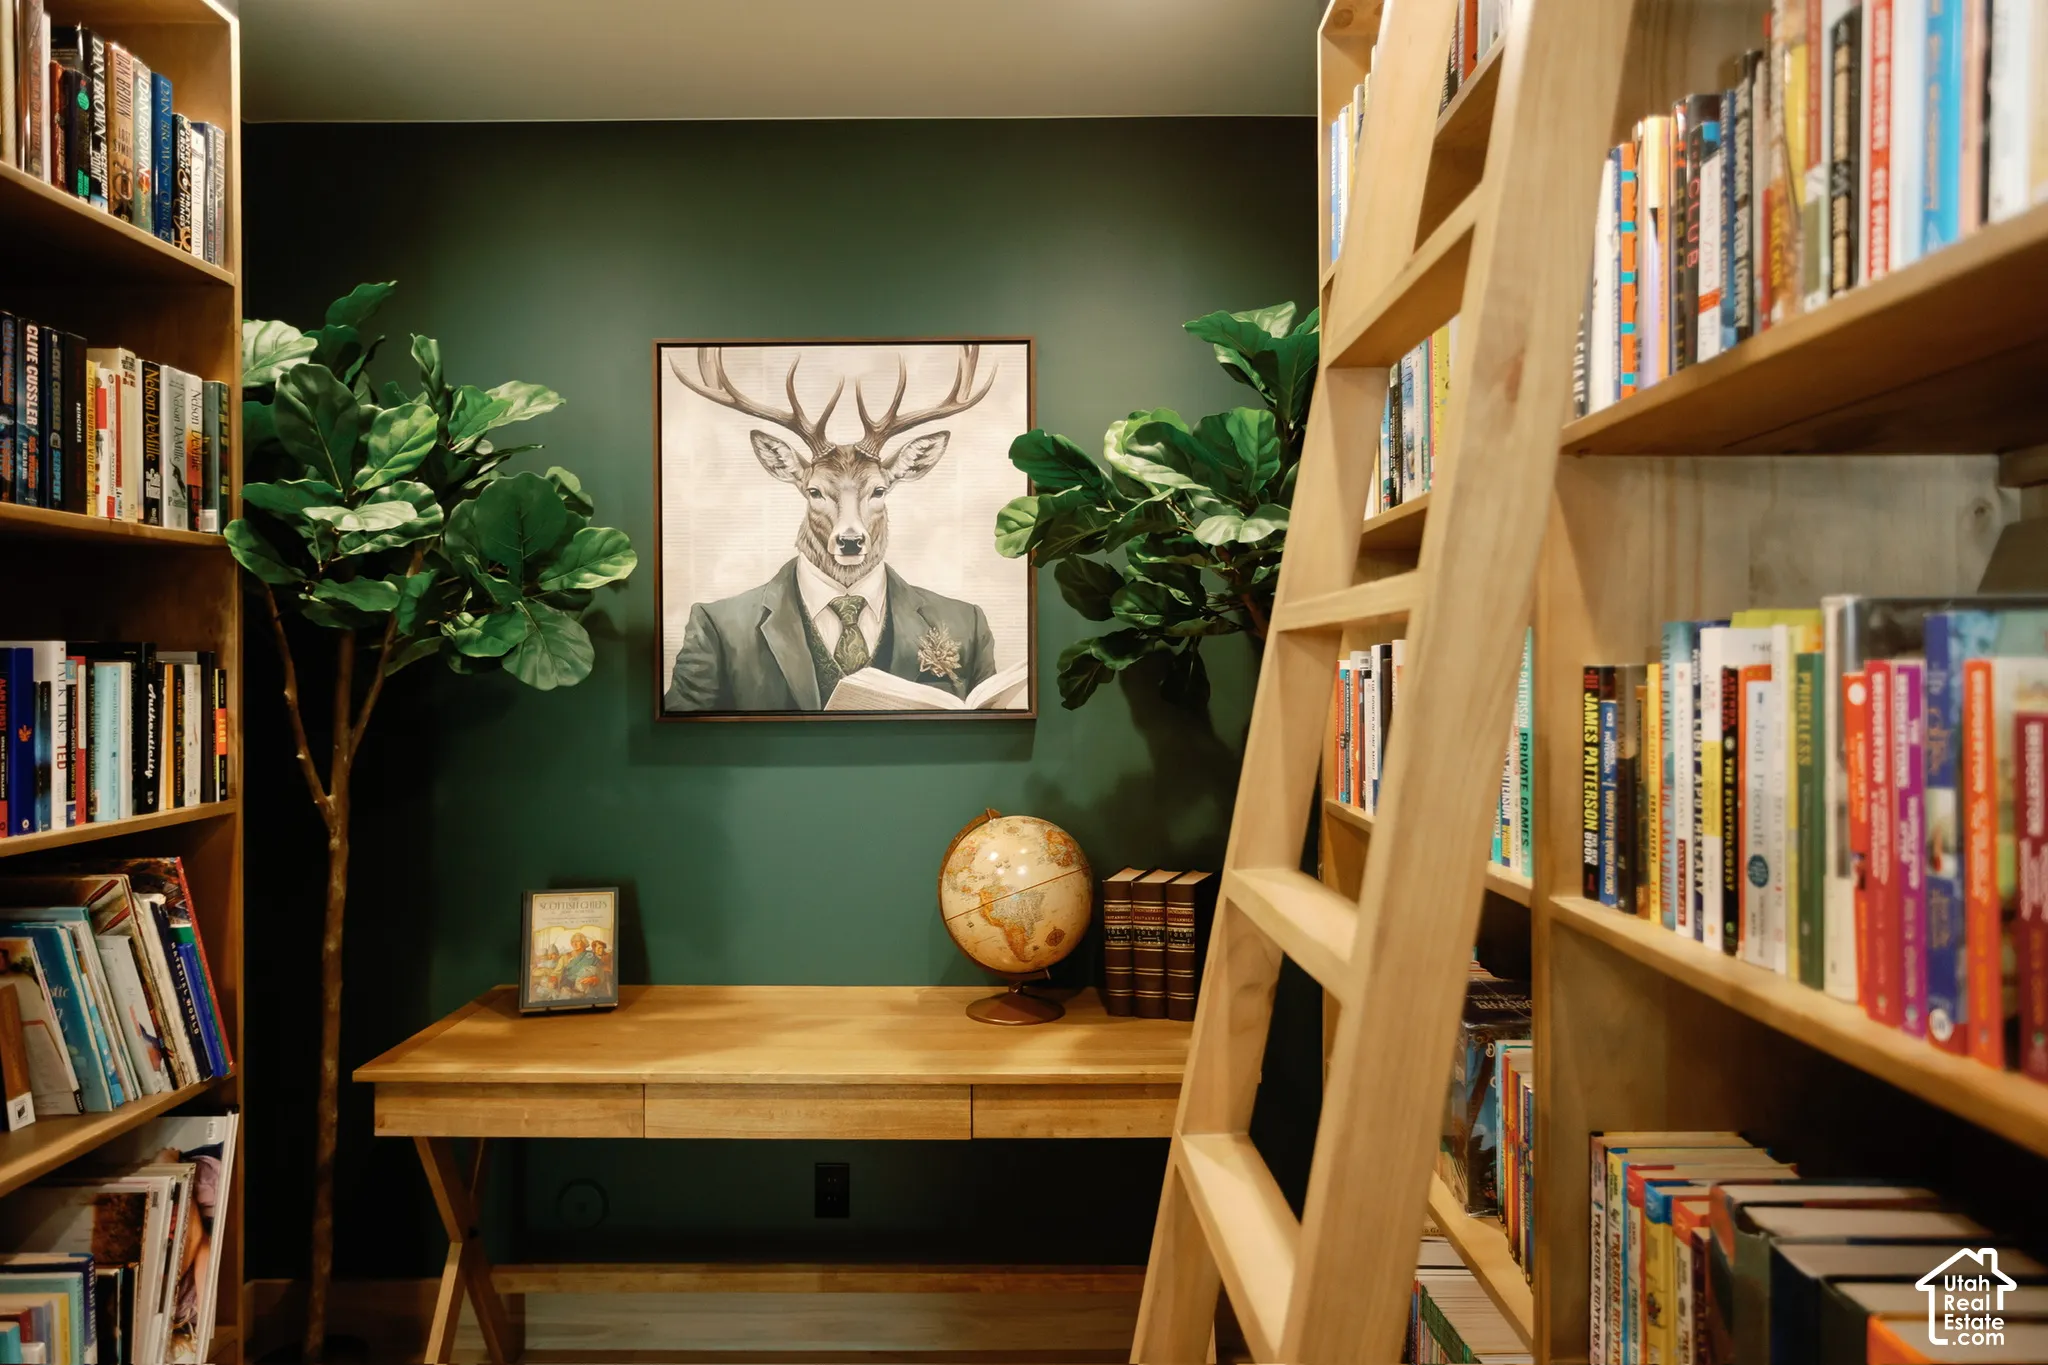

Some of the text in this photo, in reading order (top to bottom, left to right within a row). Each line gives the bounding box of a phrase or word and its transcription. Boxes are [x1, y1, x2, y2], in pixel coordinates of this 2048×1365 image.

[92, 37, 106, 139] DAN BROWN
[115, 53, 131, 77] DAN
[115, 77, 131, 120] BROWN
[159, 80, 170, 117] DAN
[91, 150, 101, 182] POINT
[100, 142, 108, 199] DECEPTION
[138, 77, 150, 176] DAN BROWN
[159, 119, 170, 177] BROWN
[1686, 178, 1701, 268] CLUB
[26, 324, 38, 426] CLIVE CUSSLER
[52, 348, 61, 431] CLIVE CUSSLER
[145, 367, 160, 461] Nelson DeMille
[174, 391, 184, 462] Nelson DeMille
[191, 389, 202, 471] Nelson DeMille
[52, 450, 61, 502] SERPENT
[144, 683, 157, 779] Authenticity
[1517, 670, 1529, 728] PATTERSON
[1797, 671, 1812, 766] PRICELESS
[1871, 672, 1886, 783] BRIDGERTON
[1895, 674, 1910, 788] BRIDGERTONS
[1970, 669, 1987, 795] BRIDGERTON
[57, 744, 67, 770] TED
[1519, 732, 1529, 848] PRIVATE GAMES
[1584, 693, 1599, 831] JAMES PATTERSON
[1753, 719, 1768, 849] Jodi Picoult
[2025, 722, 2044, 838] BRIDGERTON
[1584, 832, 1592, 864] BOOK
[1603, 790, 1615, 896] WHEN THE WIND BLOWS
[1693, 717, 1702, 895] LOST APOTHECARY
[1725, 757, 1734, 891] THE EGYPTOLOGIST
[539, 901, 607, 910] SCOTTISH CHIEFS
[1661, 819, 1672, 913] SANATORIUM
[171, 941, 199, 1035] MATERIAL WORLD
[1593, 1212, 1601, 1349] TREASURE HUNTERS
[1612, 1232, 1620, 1365] TREASURE HUNTER
